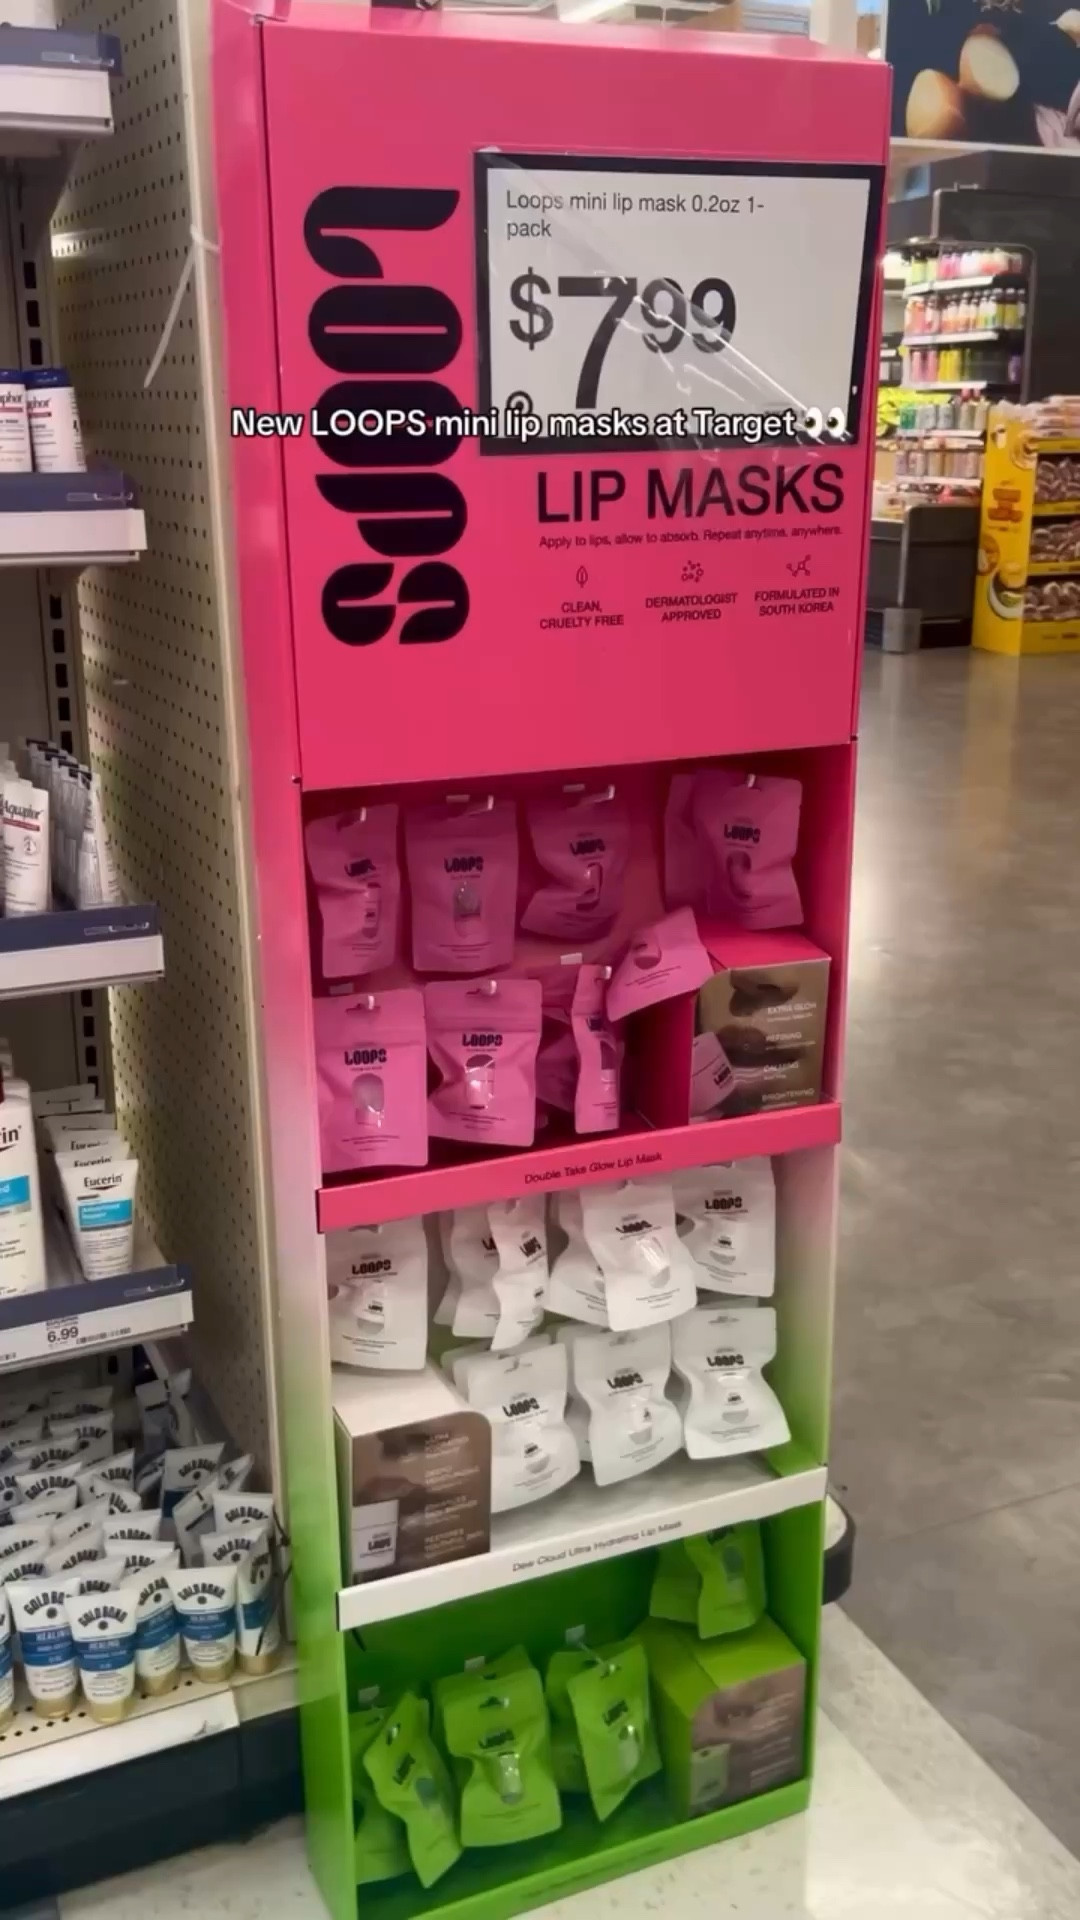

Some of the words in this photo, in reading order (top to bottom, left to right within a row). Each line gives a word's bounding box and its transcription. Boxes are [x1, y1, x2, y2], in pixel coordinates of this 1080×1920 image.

[506, 190, 564, 210] Loops
[569, 192, 607, 211] mini
[612, 192, 633, 214] lip
[638, 194, 687, 213] mask
[692, 196, 740, 213] 0.2oz
[747, 196, 765, 213] 1-
[507, 220, 552, 240] pack
[303, 186, 470, 646] LOOPS
[537, 471, 626, 523] LIP
[646, 463, 845, 520] MASKS
[539, 536, 572, 549] Apply
[575, 535, 587, 547] to
[589, 533, 612, 547] lips,
[615, 532, 643, 545] allow
[646, 532, 658, 544] to
[660, 530, 699, 543] absorb.
[703, 529, 742, 543] Repeat
[791, 525, 842, 539] anywhere.
[645, 592, 738, 609] DERMATOLOGIST
[754, 588, 827, 602] FORMULATED
[828, 587, 840, 598] IN
[561, 600, 602, 614] CLEAN,
[661, 609, 722, 623] APPROVED
[759, 603, 796, 617] SOUTH
[798, 602, 834, 614] KOREA
[540, 616, 591, 630] CRUELTY
[594, 615, 625, 626] FREE
[724, 823, 761, 843] LOOPS
[444, 856, 484, 873] LOOPS
[462, 1033, 503, 1048] LOOPS
[344, 1048, 388, 1066] LOOPS
[524, 1169, 561, 1185] Double
[564, 1164, 587, 1178] Take
[589, 1161, 616, 1174] Glow
[617, 1156, 634, 1169] Lip
[635, 1152, 663, 1165] Mask
[84, 1174, 123, 1187] Eucerin
[704, 1196, 743, 1210] LOOPS
[352, 1259, 391, 1275] LOOPS
[47, 1326, 79, 1343] 6.99
[706, 1353, 745, 1368] LOOPS
[607, 1372, 643, 1390] LOOPS
[502, 1397, 540, 1418] LOOPS
[512, 1560, 534, 1572] Dew
[537, 1551, 567, 1566] Cloud
[568, 1545, 591, 1558] Ultra
[594, 1531, 640, 1551] Hydrating
[641, 1526, 656, 1538] Lip
[658, 1520, 683, 1534] Mask
[177, 1583, 200, 1601] GOLD
[201, 1582, 226, 1600] BOND
[23, 1592, 50, 1616] GOLD
[77, 1607, 102, 1627] GOLD
[102, 1605, 129, 1624] BOND
